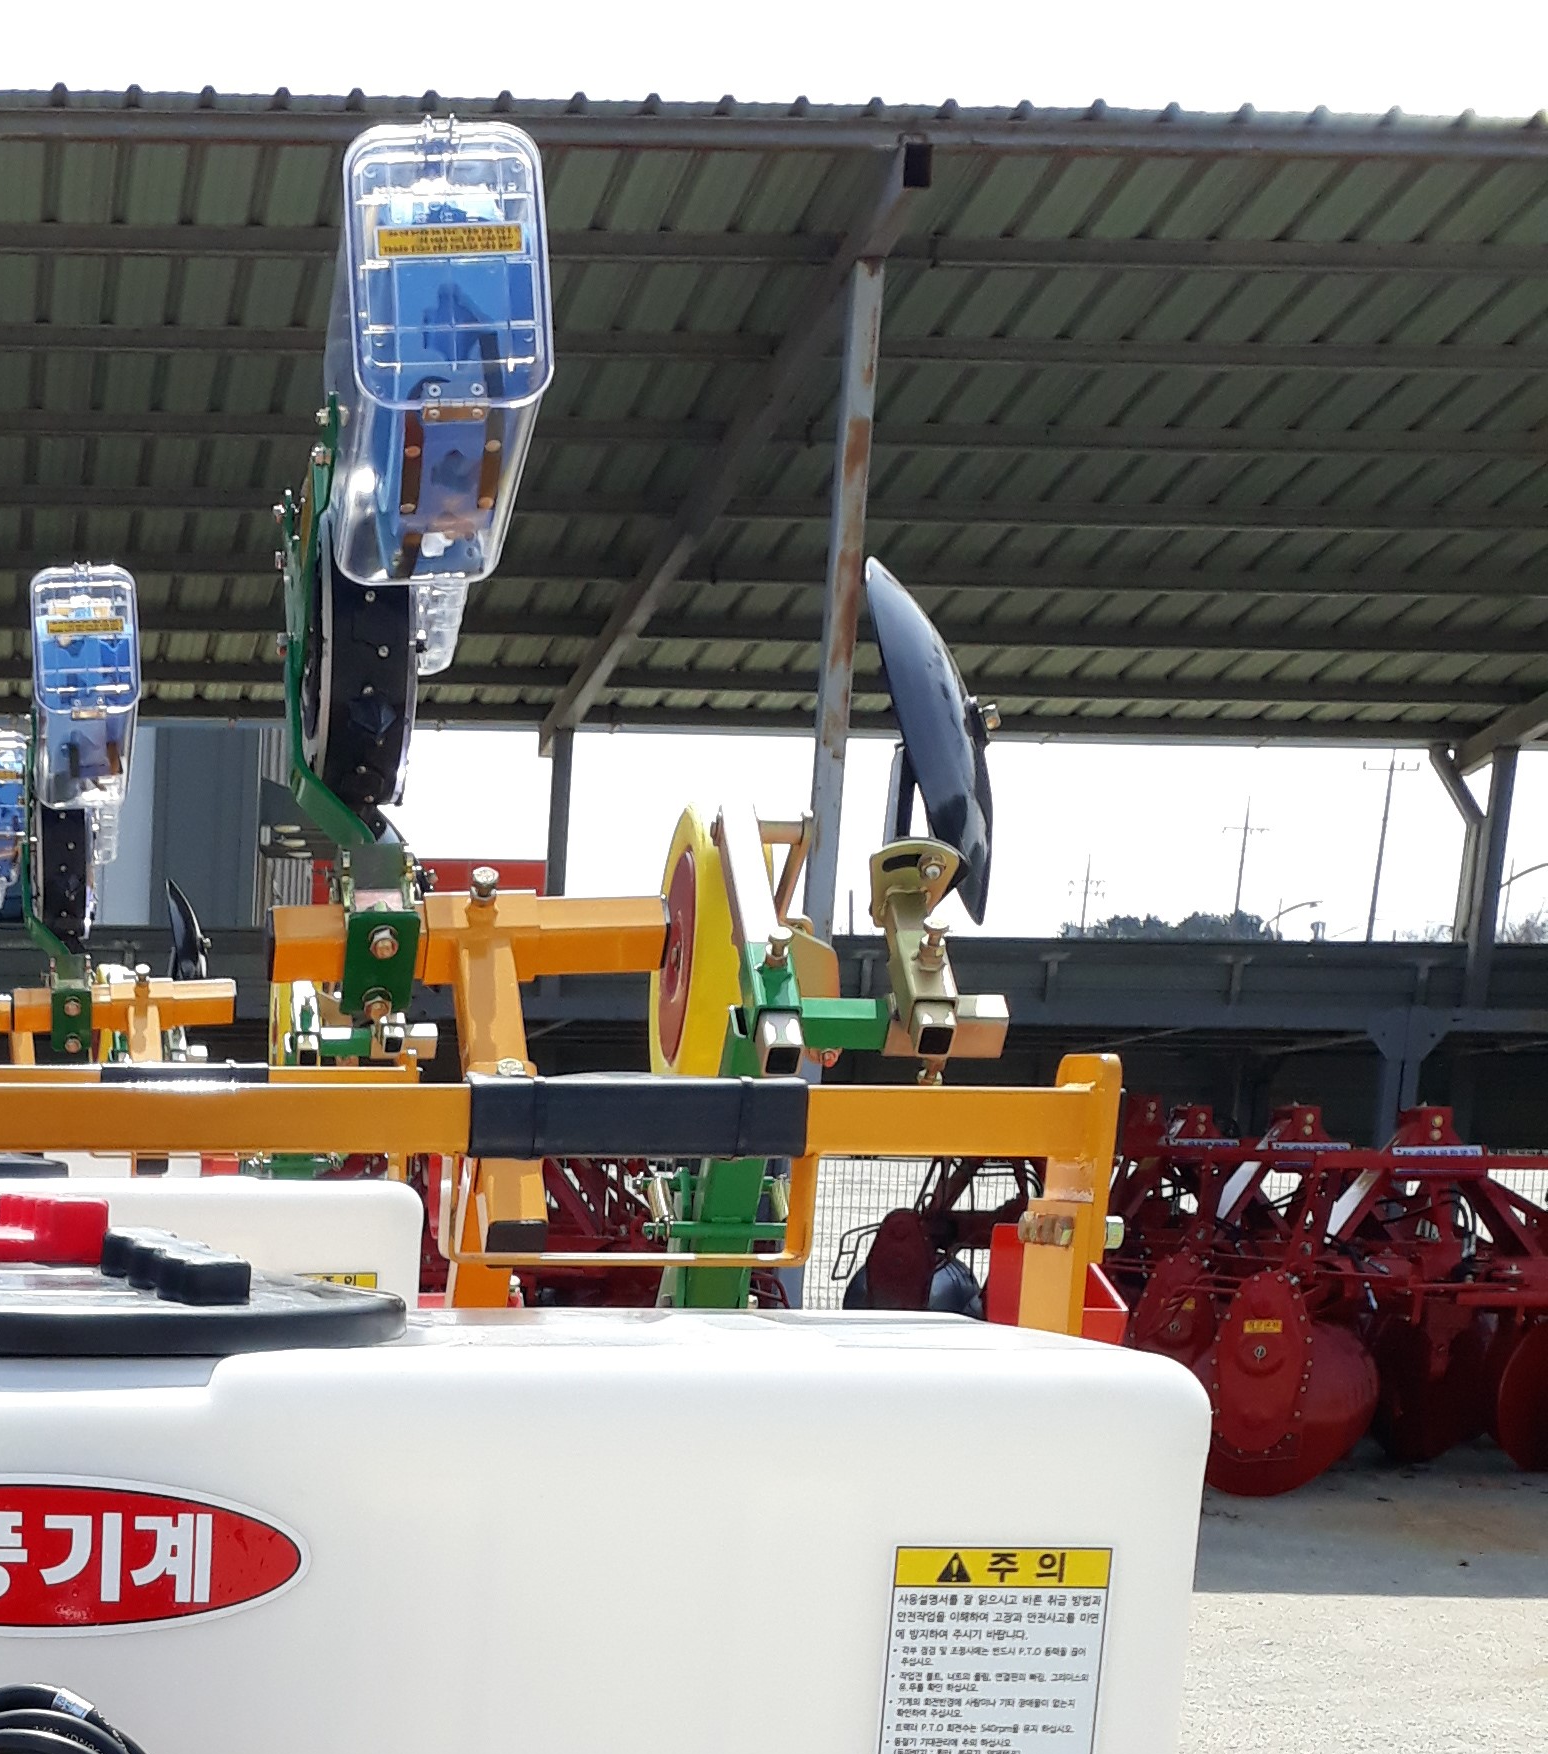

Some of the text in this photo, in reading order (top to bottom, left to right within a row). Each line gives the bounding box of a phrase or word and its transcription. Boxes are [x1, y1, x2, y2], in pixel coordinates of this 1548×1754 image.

[898, 1593, 957, 1605] 사용설명서를
[963, 1594, 972, 1605] 잘
[1022, 1595, 1041, 1606] 바른
[1071, 1595, 1101, 1607] 방법과
[897, 1611, 944, 1622] 안전작업을
[950, 1611, 988, 1623] 이해하여
[993, 1612, 1021, 1623] 고장과
[1027, 1612, 1074, 1624] 안전사고를
[909, 1628, 947, 1639] 방지하여
[952, 1629, 981, 1640] 주시기
